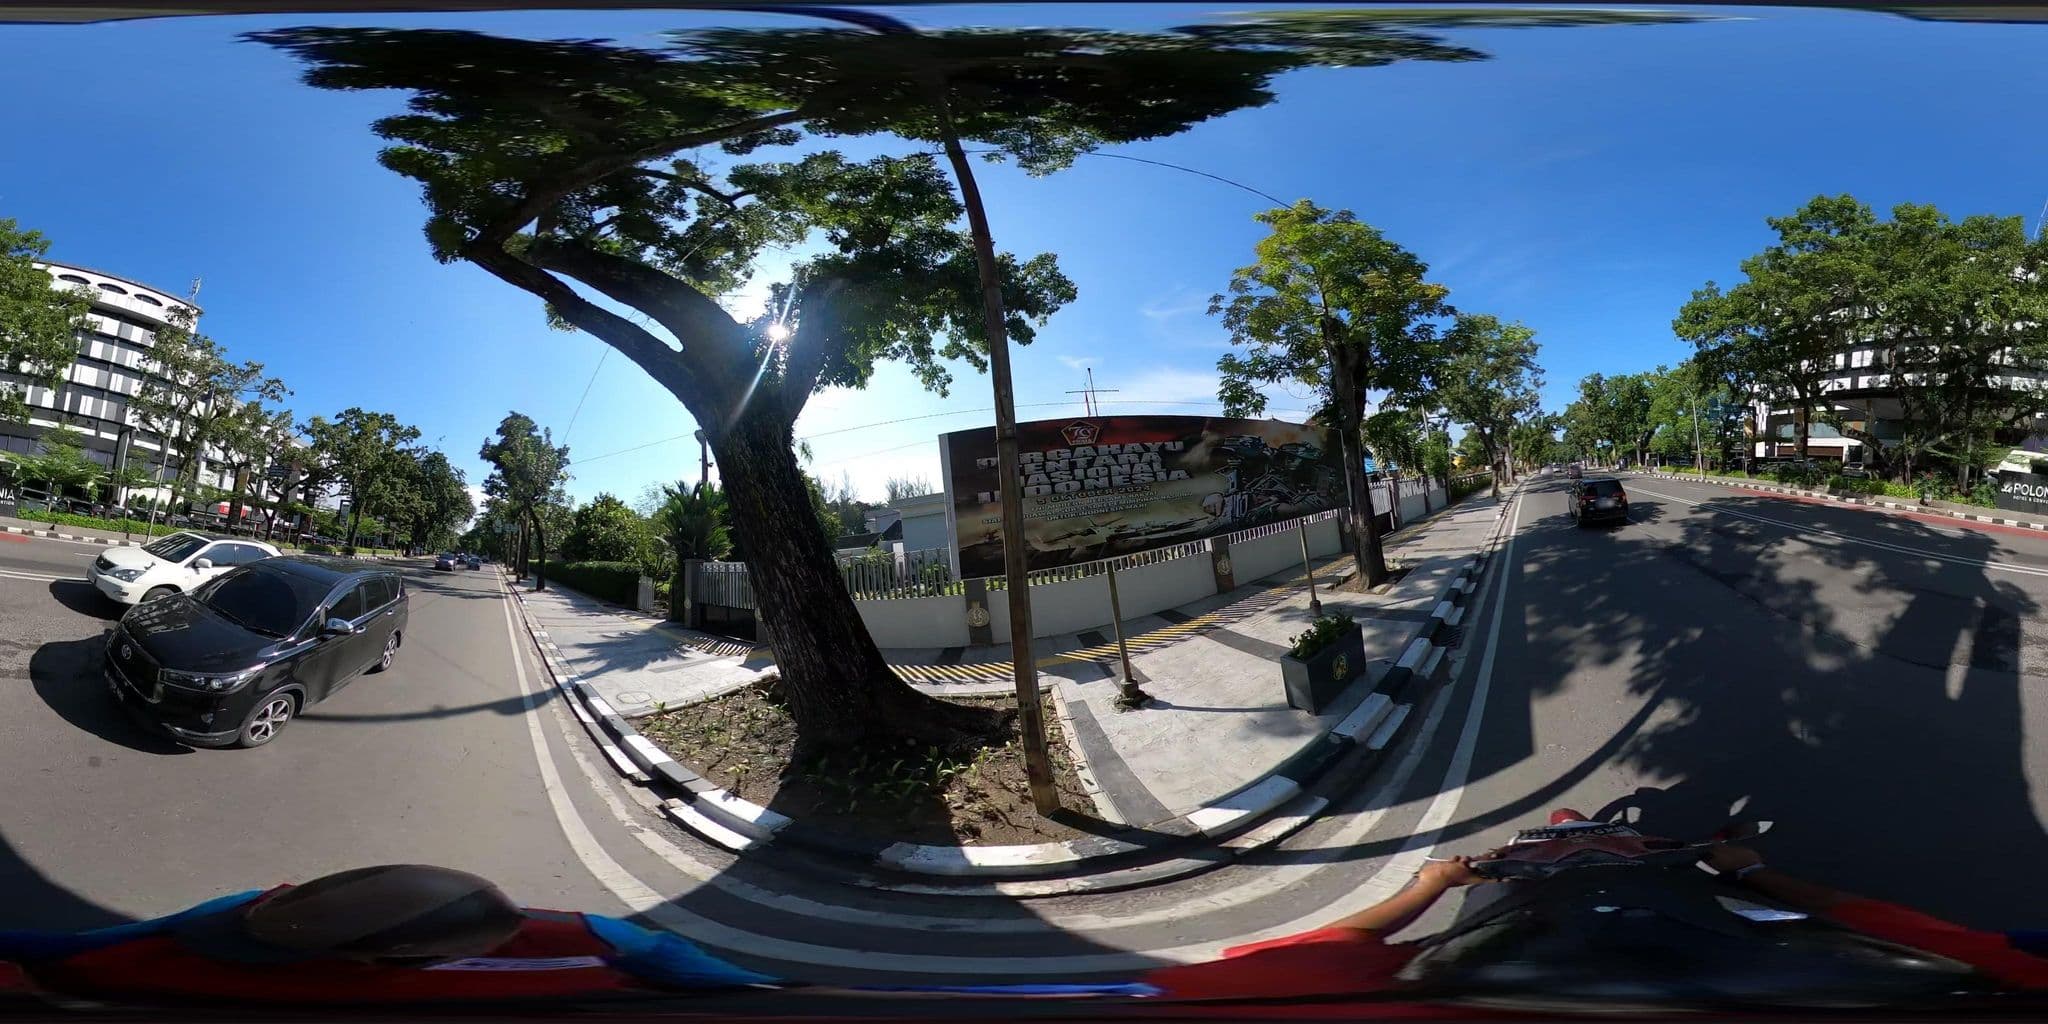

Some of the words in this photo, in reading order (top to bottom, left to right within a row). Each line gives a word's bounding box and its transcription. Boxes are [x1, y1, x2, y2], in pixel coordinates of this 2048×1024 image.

[977, 441, 1184, 470] DRGAHAYU
[1019, 452, 1162, 475] ENTARA
[1020, 462, 1167, 487] ASIONAL
